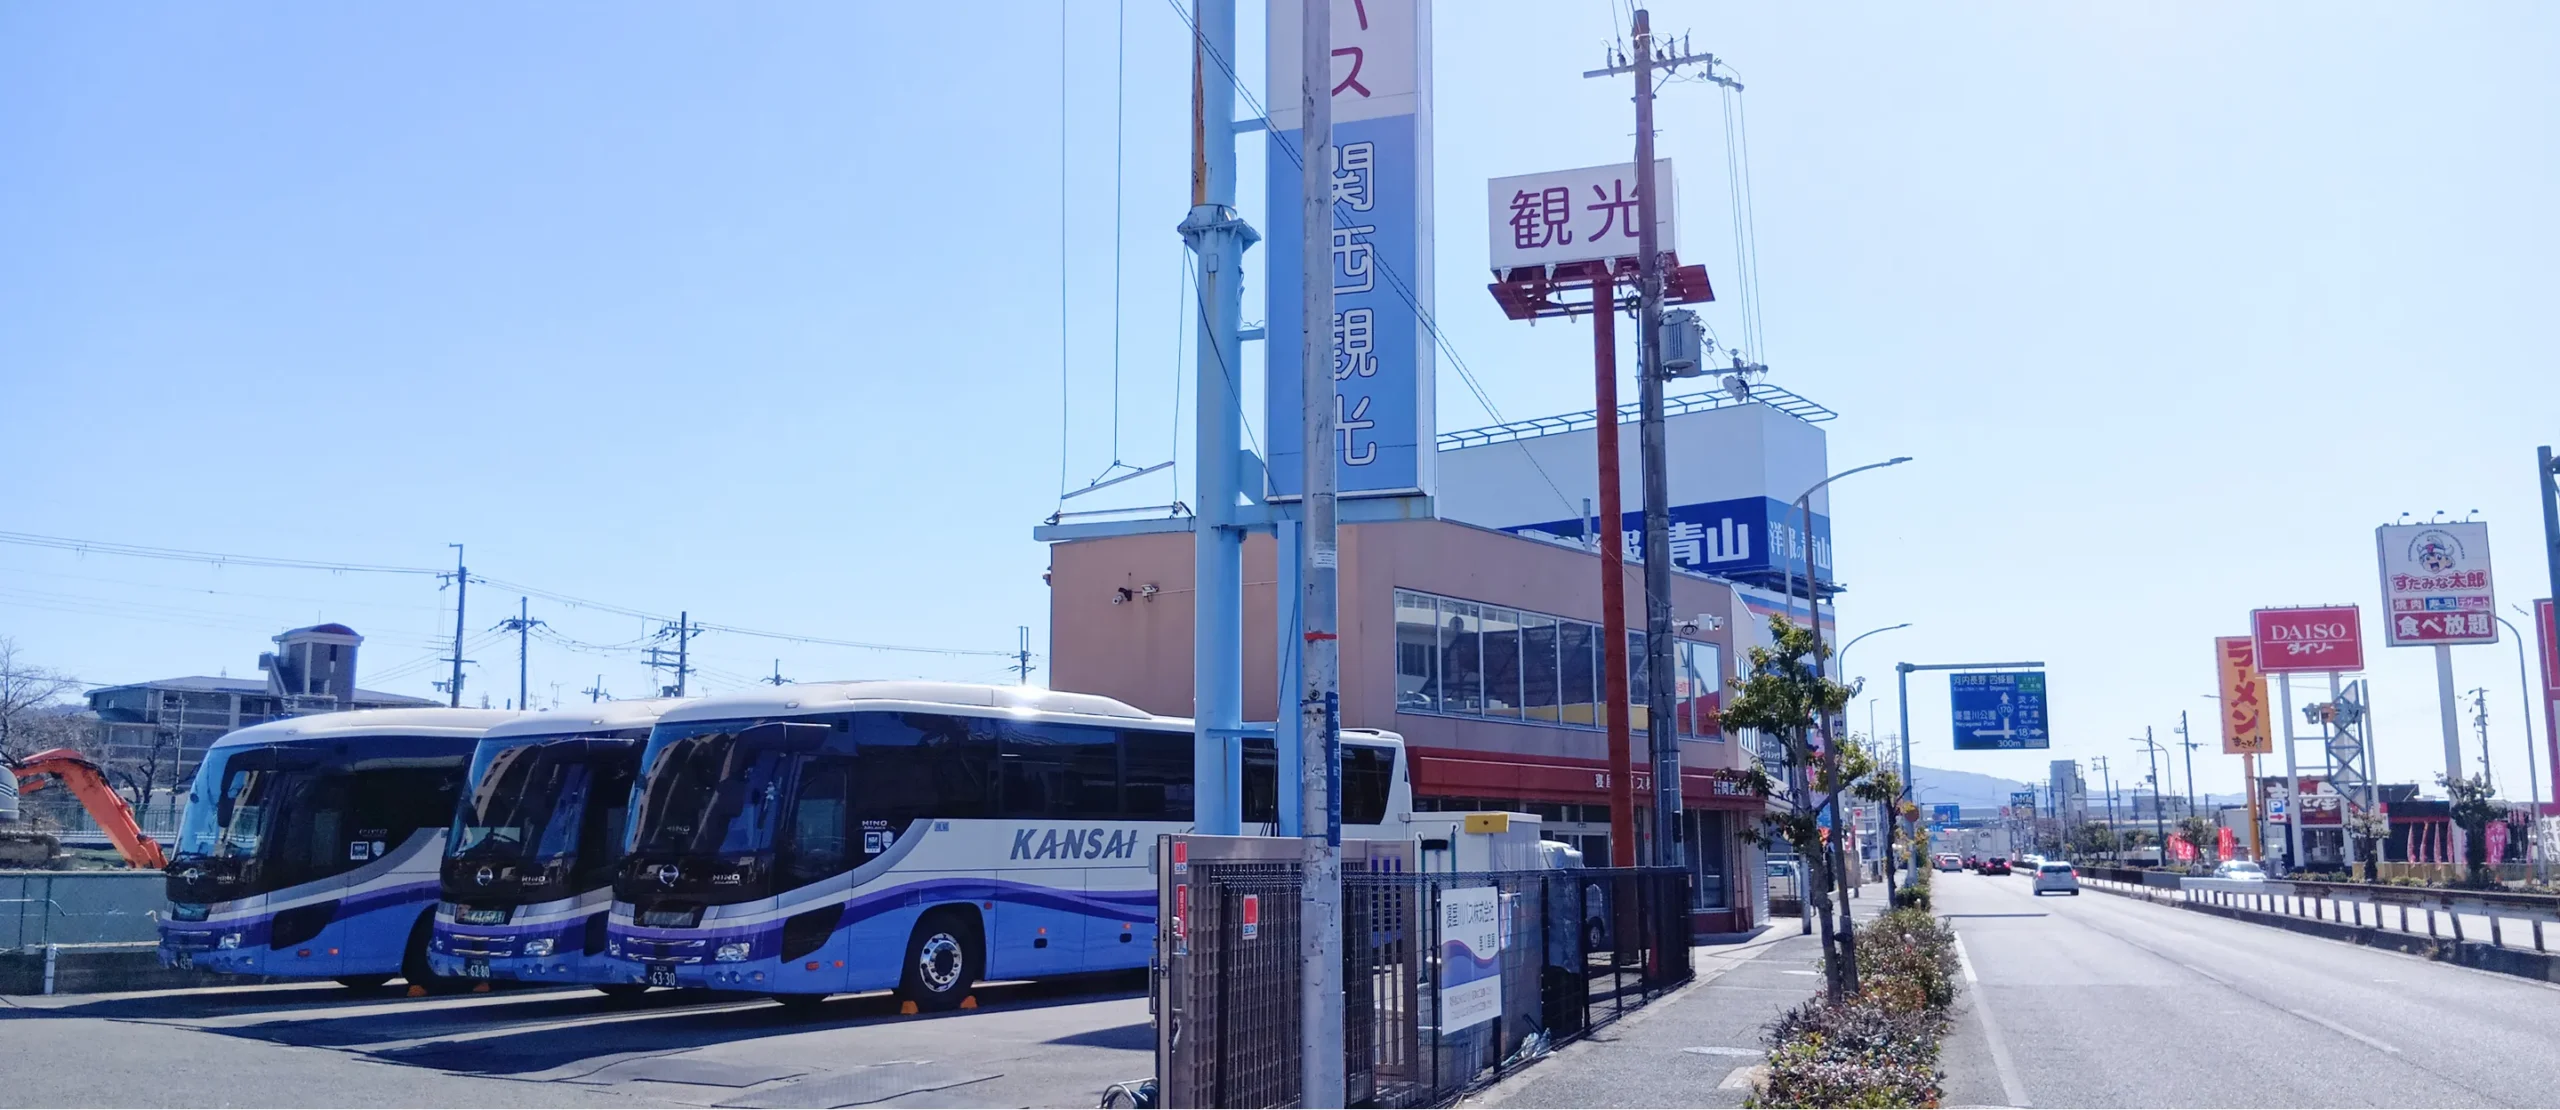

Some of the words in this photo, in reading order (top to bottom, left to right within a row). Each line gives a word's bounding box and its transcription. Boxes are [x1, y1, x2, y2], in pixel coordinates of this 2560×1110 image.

[1509, 178, 1641, 250] 観光
[2393, 572, 2486, 591] すたみな太郎
[2271, 623, 2347, 641] DAISO
[2398, 613, 2490, 637] 食べ放題
[2287, 642, 2334, 655] ダイソー
[2227, 641, 2259, 735] ラーメン
[1010, 828, 1138, 860] KANSAI
